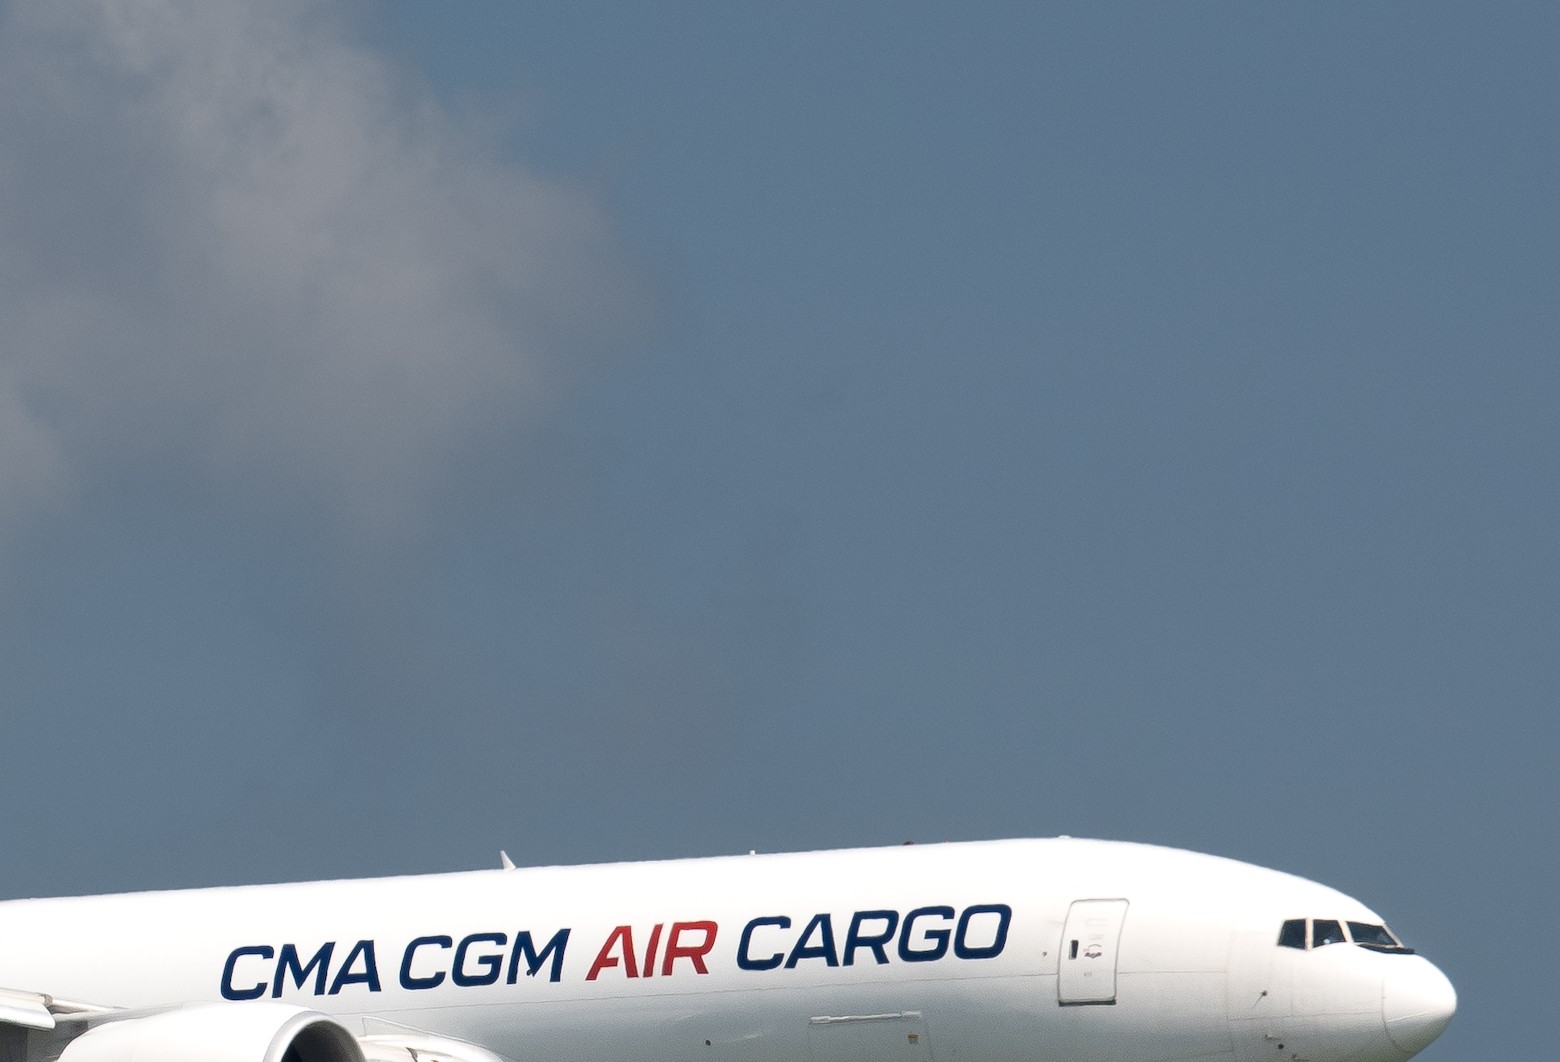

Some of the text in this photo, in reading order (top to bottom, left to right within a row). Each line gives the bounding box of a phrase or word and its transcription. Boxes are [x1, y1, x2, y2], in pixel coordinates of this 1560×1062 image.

[219, 903, 1013, 1001] CMA CGM AIR CARGO
